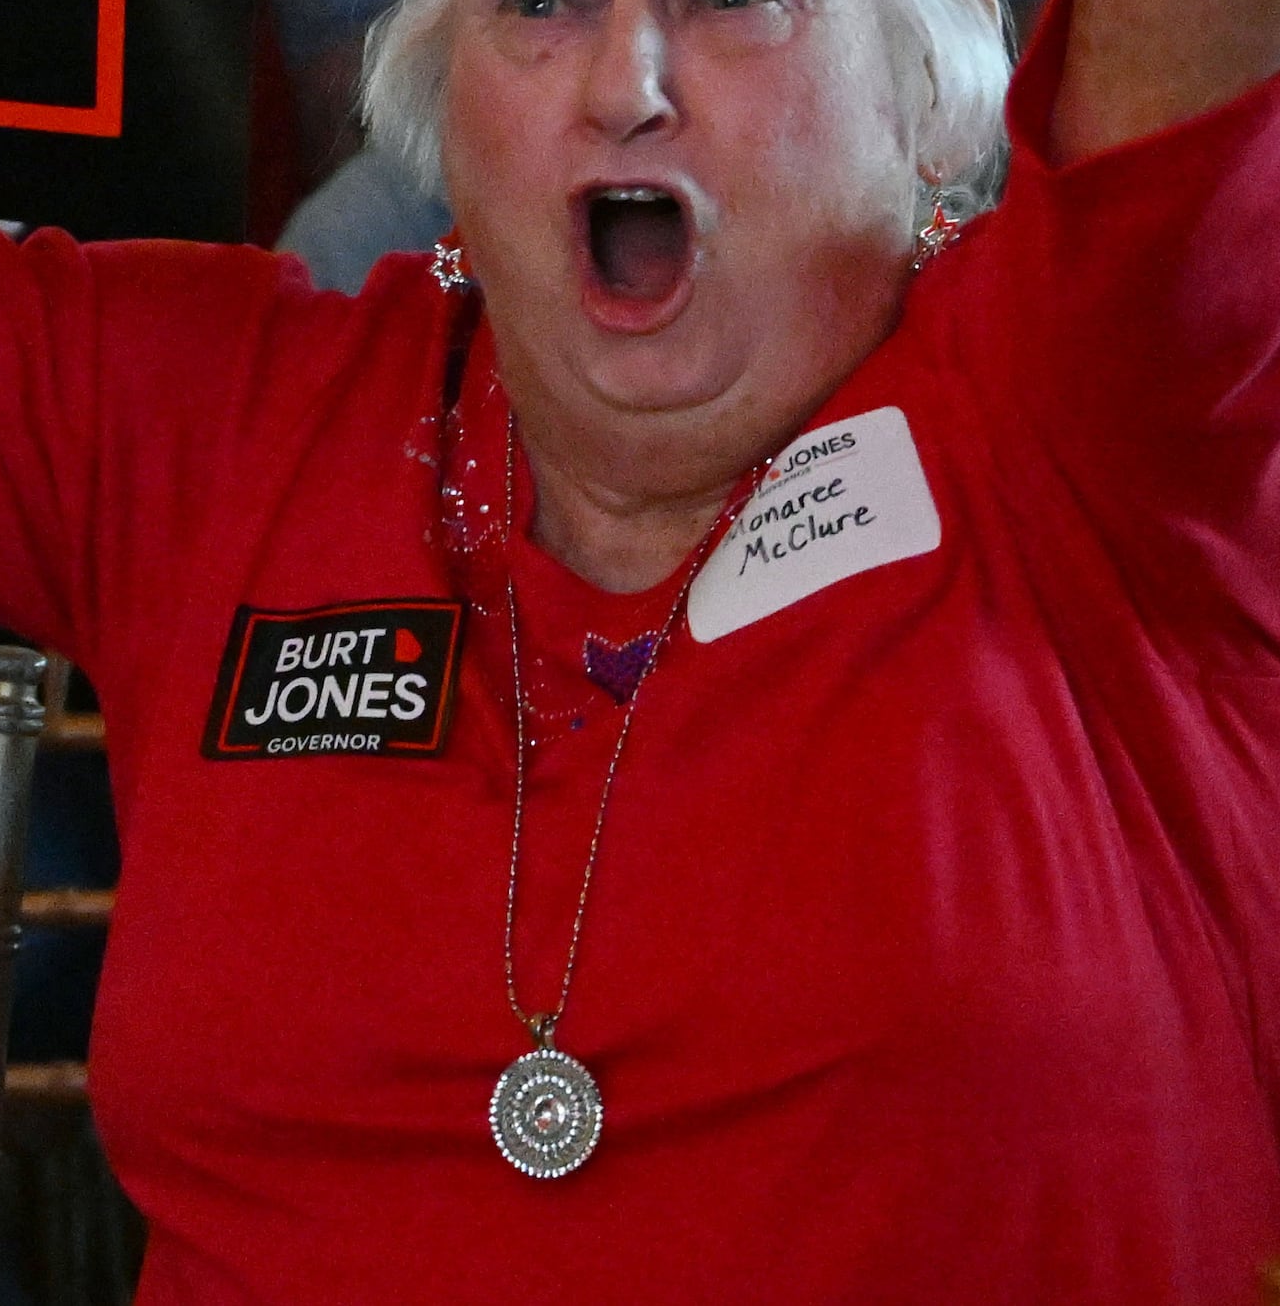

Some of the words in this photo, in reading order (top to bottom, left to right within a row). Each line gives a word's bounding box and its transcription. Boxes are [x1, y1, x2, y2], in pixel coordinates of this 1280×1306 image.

[783, 432, 857, 474] JONES
[738, 504, 877, 577] McClure
[275, 628, 387, 673] BURT
[244, 673, 428, 726] JONES
[267, 734, 381, 754] GOVERNOR
